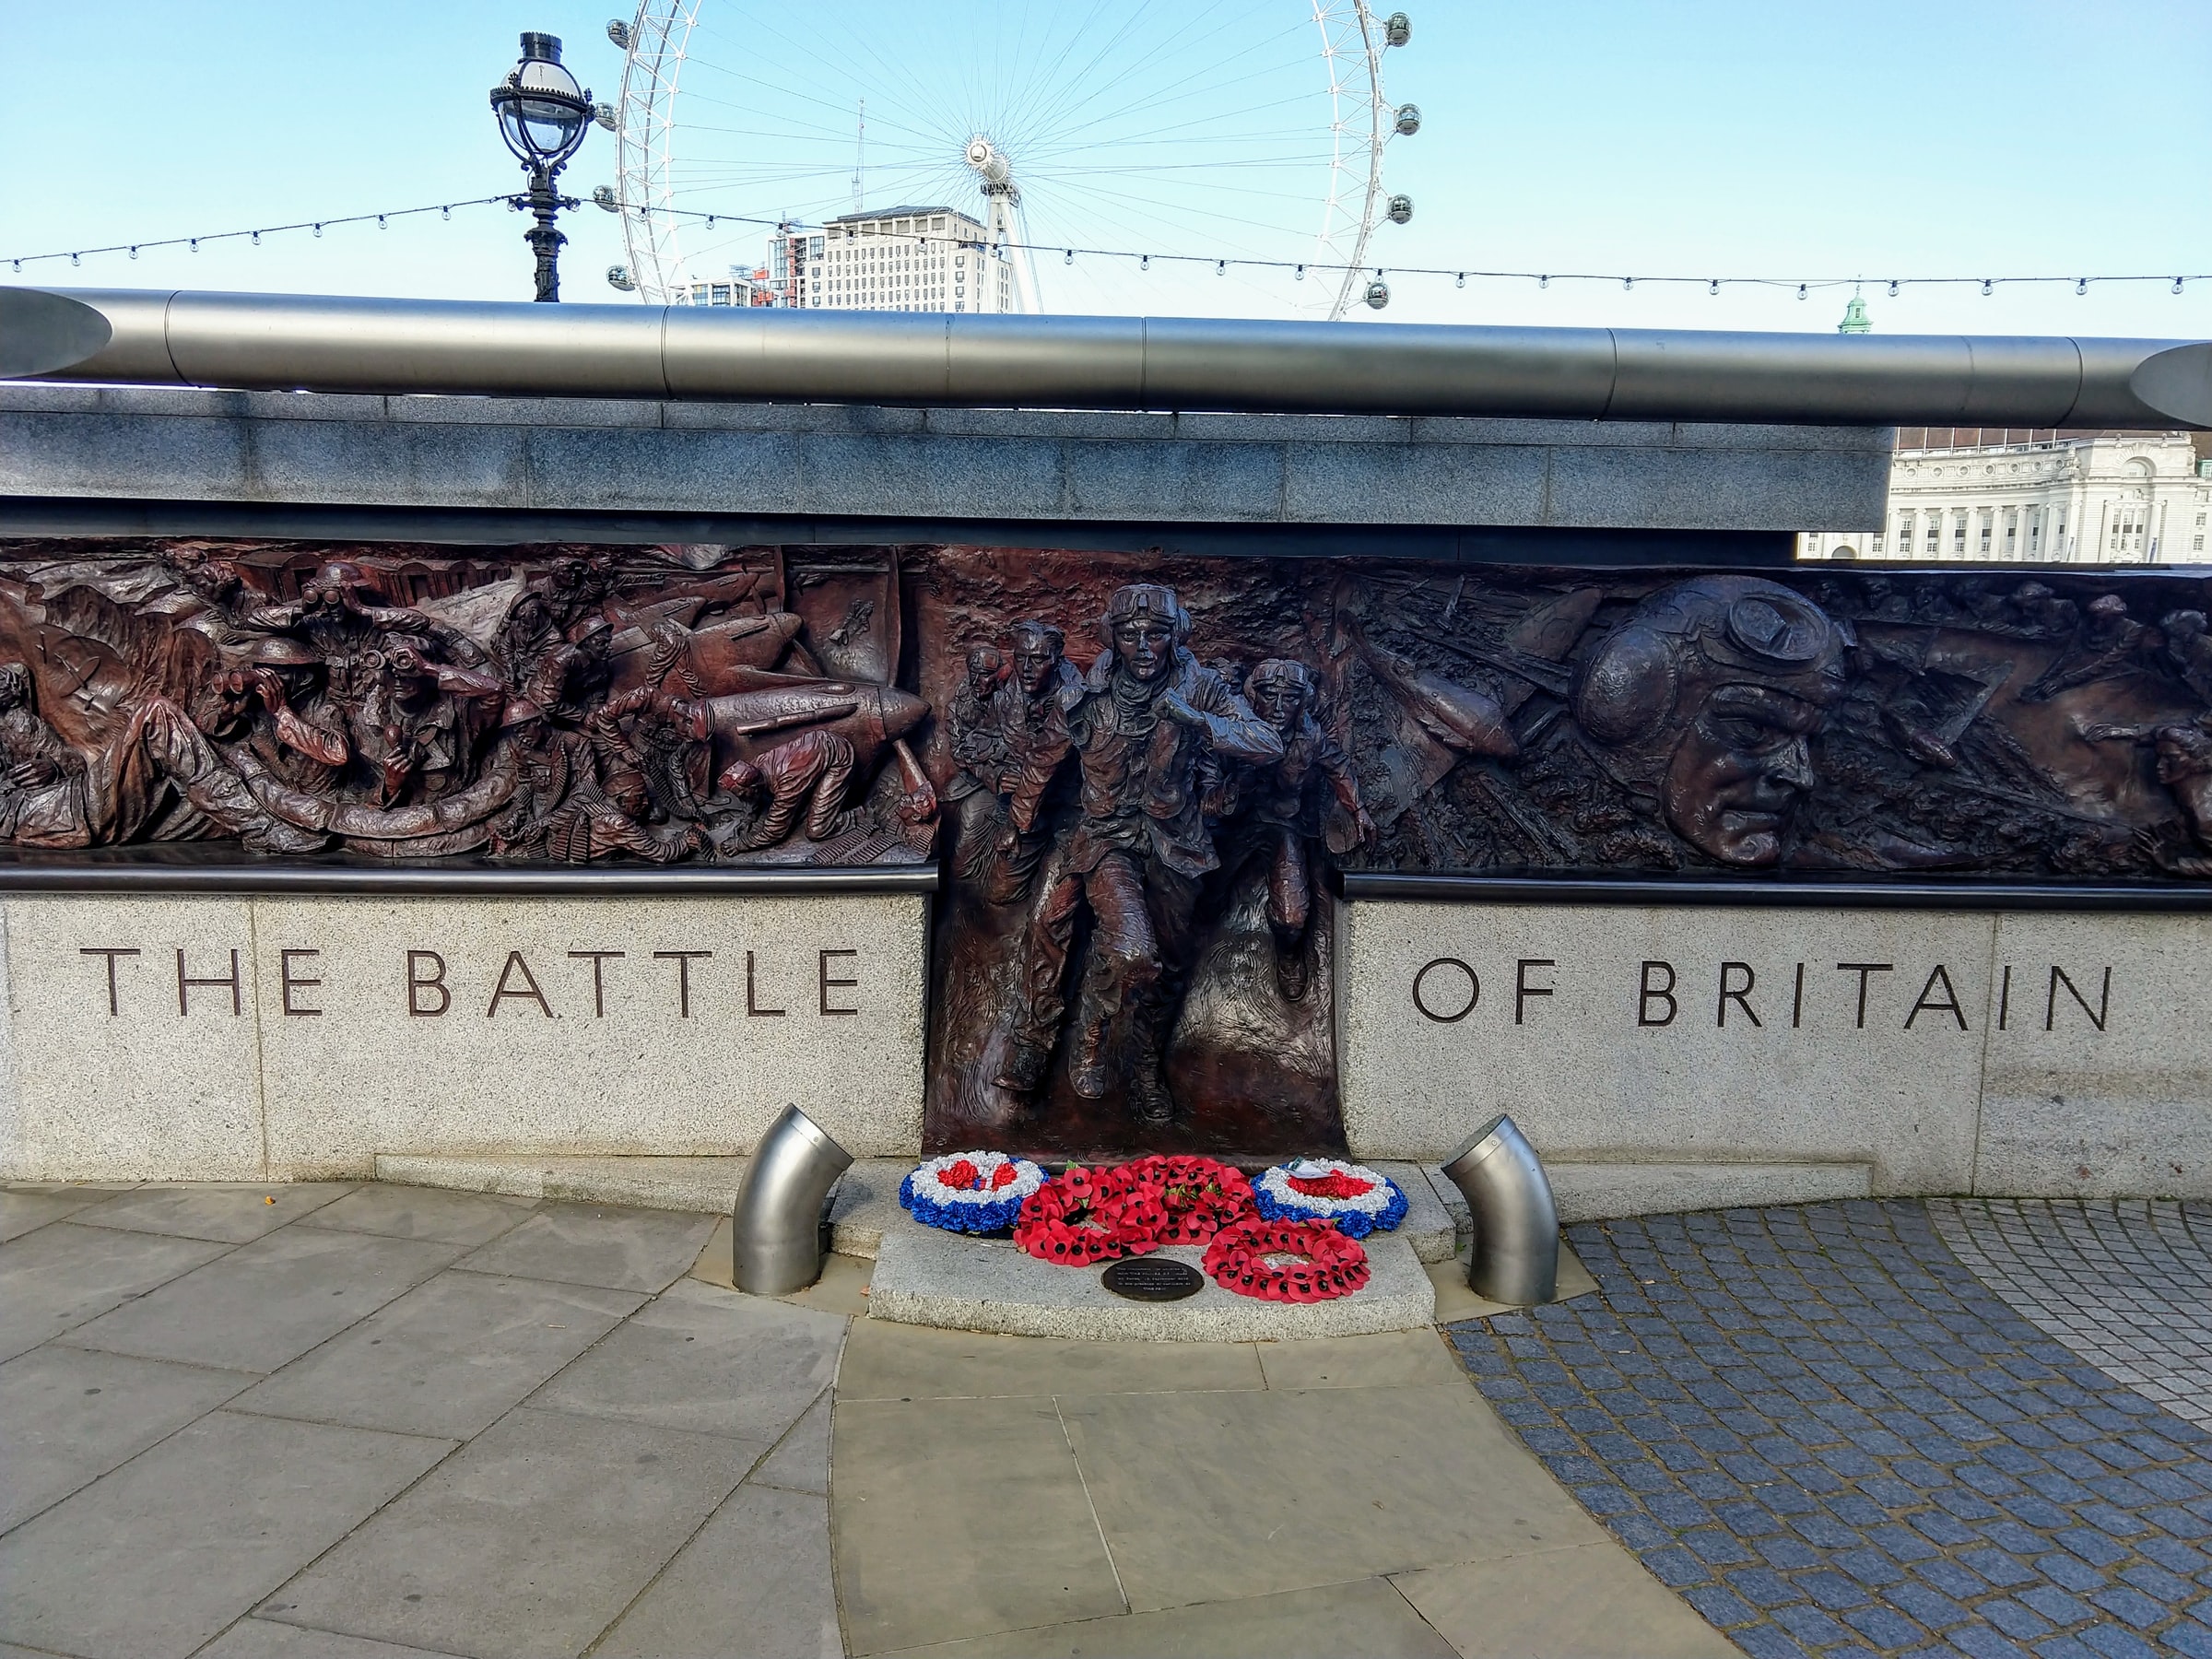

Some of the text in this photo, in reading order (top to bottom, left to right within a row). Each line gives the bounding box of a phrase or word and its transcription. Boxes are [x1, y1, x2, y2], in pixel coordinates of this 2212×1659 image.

[79, 947, 2112, 1031] THE BATTLE OF BRITAIN
